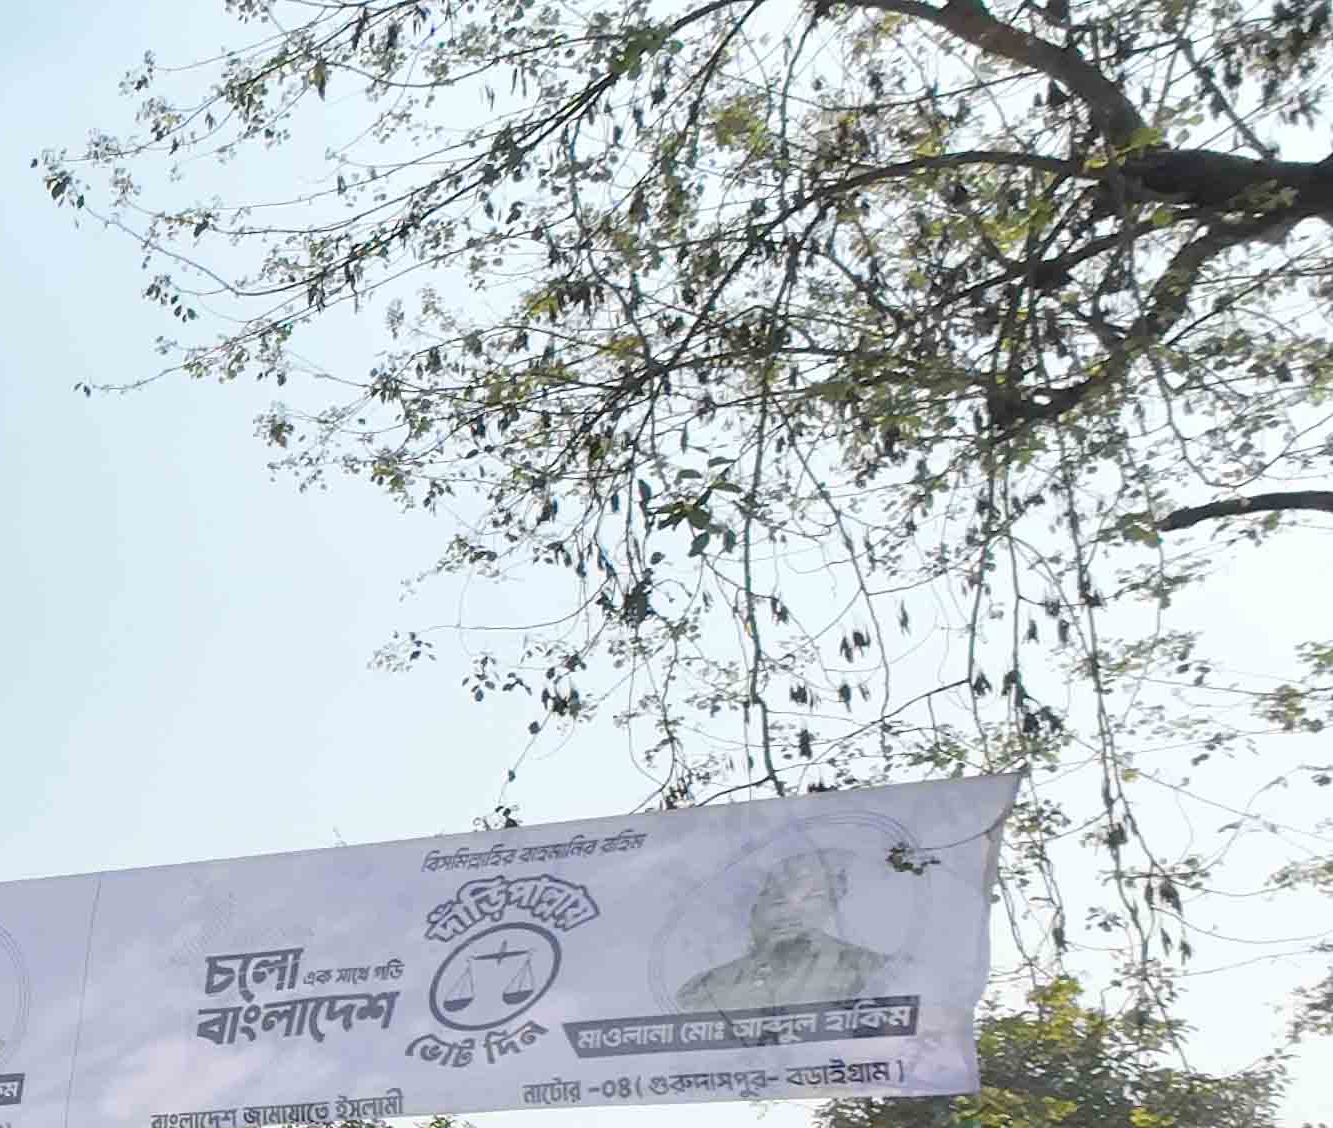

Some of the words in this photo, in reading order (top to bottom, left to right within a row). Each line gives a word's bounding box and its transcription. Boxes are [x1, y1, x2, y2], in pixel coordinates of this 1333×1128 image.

[425, 874, 600, 942] দাঁড়িপাল্লায়
[205, 948, 304, 1002] চলো
[303, 969, 332, 985] এক
[336, 966, 371, 985] সাথে
[197, 991, 400, 1044] বাংলাদেশ
[577, 1024, 672, 1049] মাওলানা
[681, 1021, 724, 1044] মোঃ
[732, 1015, 817, 1044] আব্দুল
[825, 1000, 912, 1032] হাকিম
[405, 1033, 475, 1068] ভোট
[483, 1021, 549, 1064] দিন
[243, 1101, 330, 1126] জামায়াতে
[335, 1088, 403, 1120] ইসলামী
[523, 1077, 581, 1105] নাটোর
